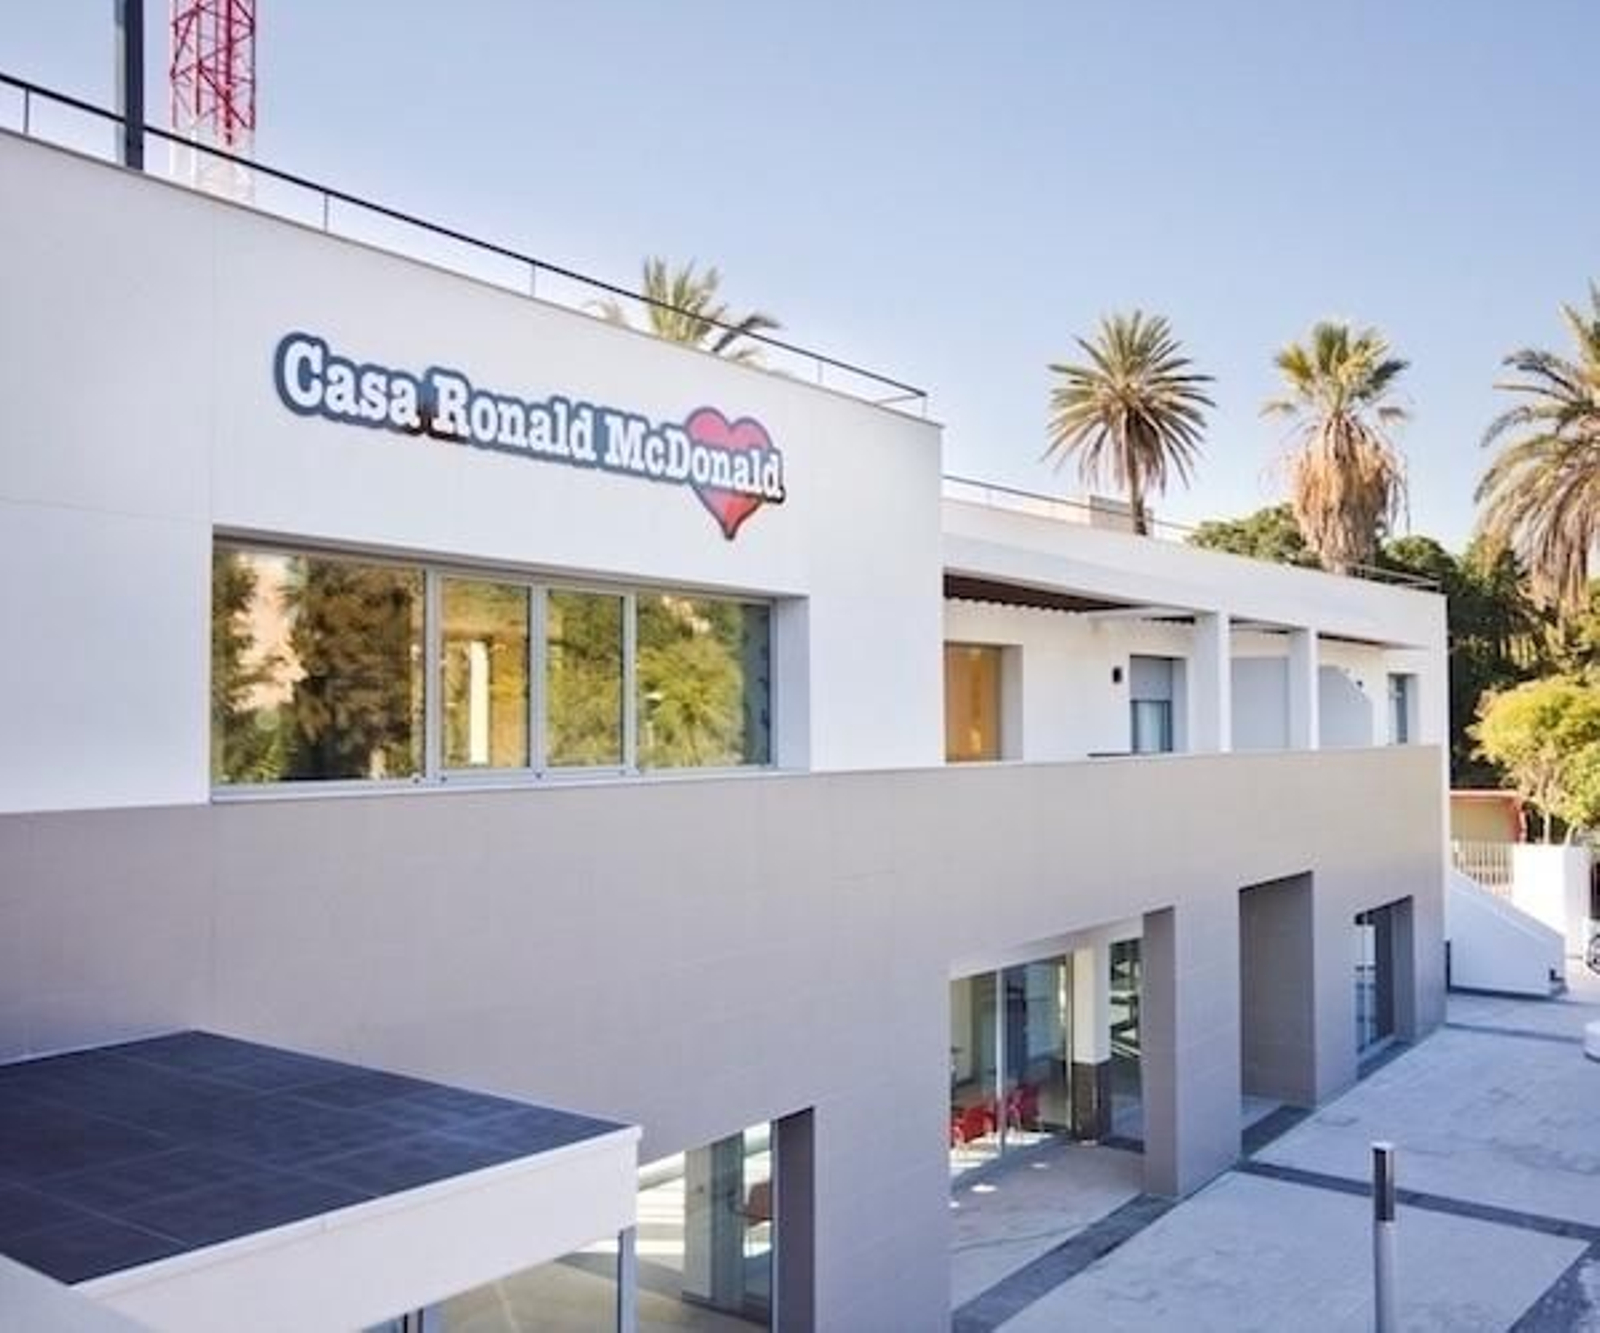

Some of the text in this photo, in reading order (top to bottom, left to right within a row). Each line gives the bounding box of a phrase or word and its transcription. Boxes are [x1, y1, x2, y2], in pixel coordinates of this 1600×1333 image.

[281, 337, 784, 501] Casa Ronald McDonald
